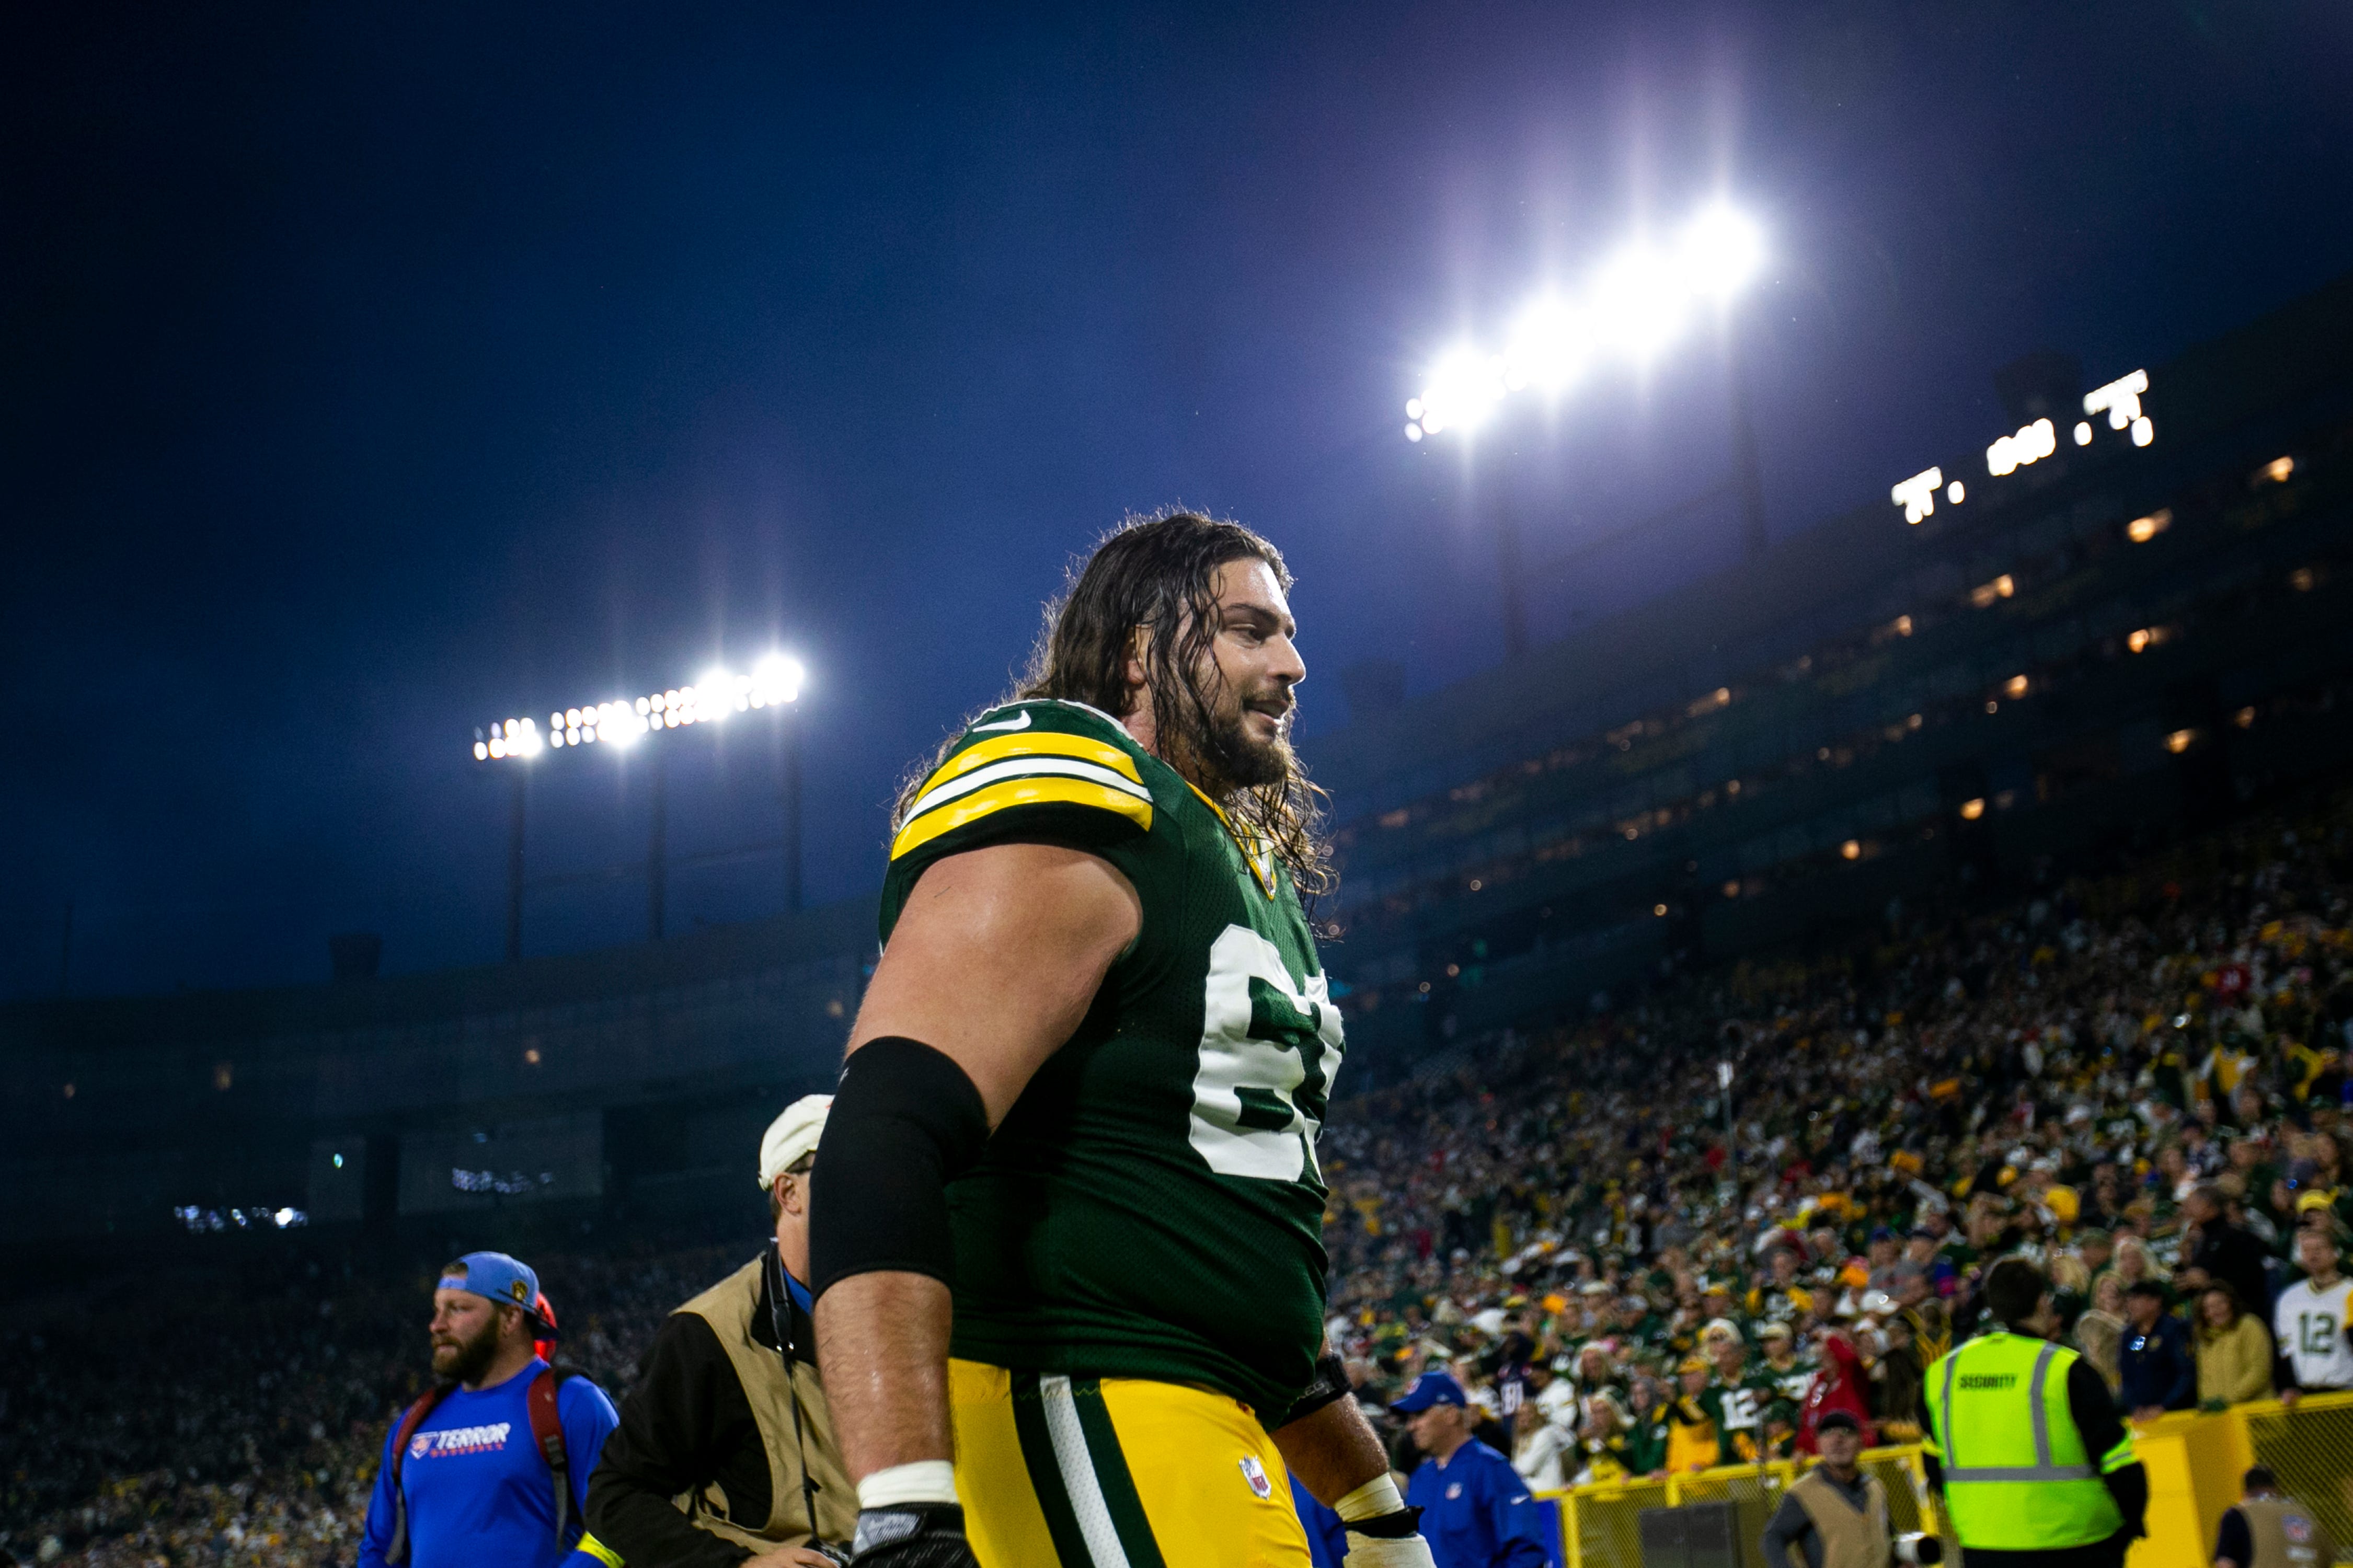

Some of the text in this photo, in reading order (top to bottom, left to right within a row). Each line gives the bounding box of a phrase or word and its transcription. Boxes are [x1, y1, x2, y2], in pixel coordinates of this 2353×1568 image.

[2299, 1312, 2335, 1354] 12
[1959, 1374, 2018, 1390] SECURITY
[1719, 1388, 1760, 1429] 12
[437, 1422, 511, 1450] TERROR
